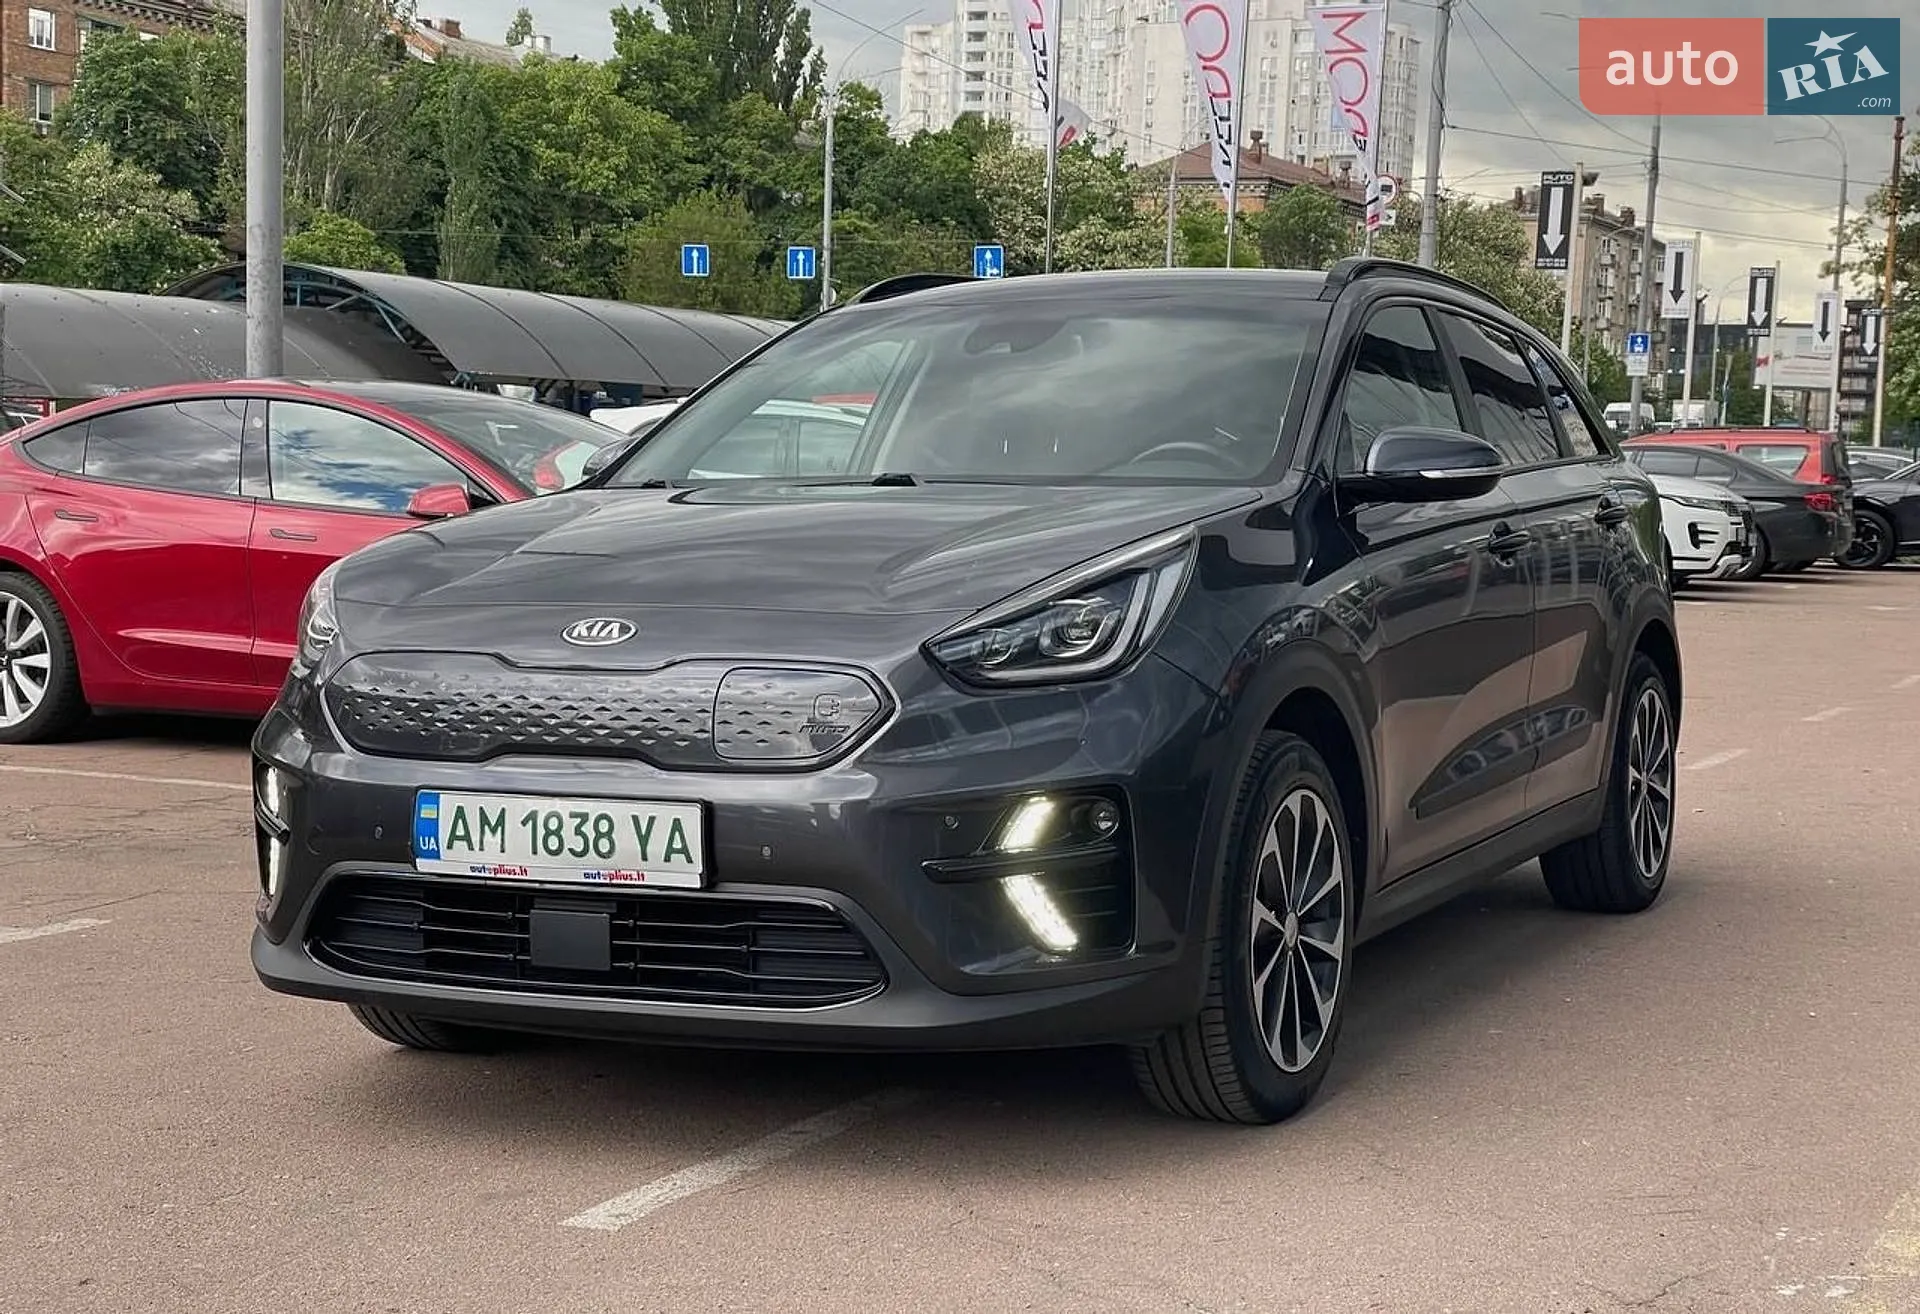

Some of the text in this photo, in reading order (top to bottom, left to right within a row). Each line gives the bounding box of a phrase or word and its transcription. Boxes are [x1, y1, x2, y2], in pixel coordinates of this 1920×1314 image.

[571, 621, 621, 639] KIA
[446, 805, 694, 864] AM 1838 YA
[420, 836, 438, 850] UA
[469, 864, 528, 877] autoplius.lt
[583, 869, 645, 882] autoplius.lt
